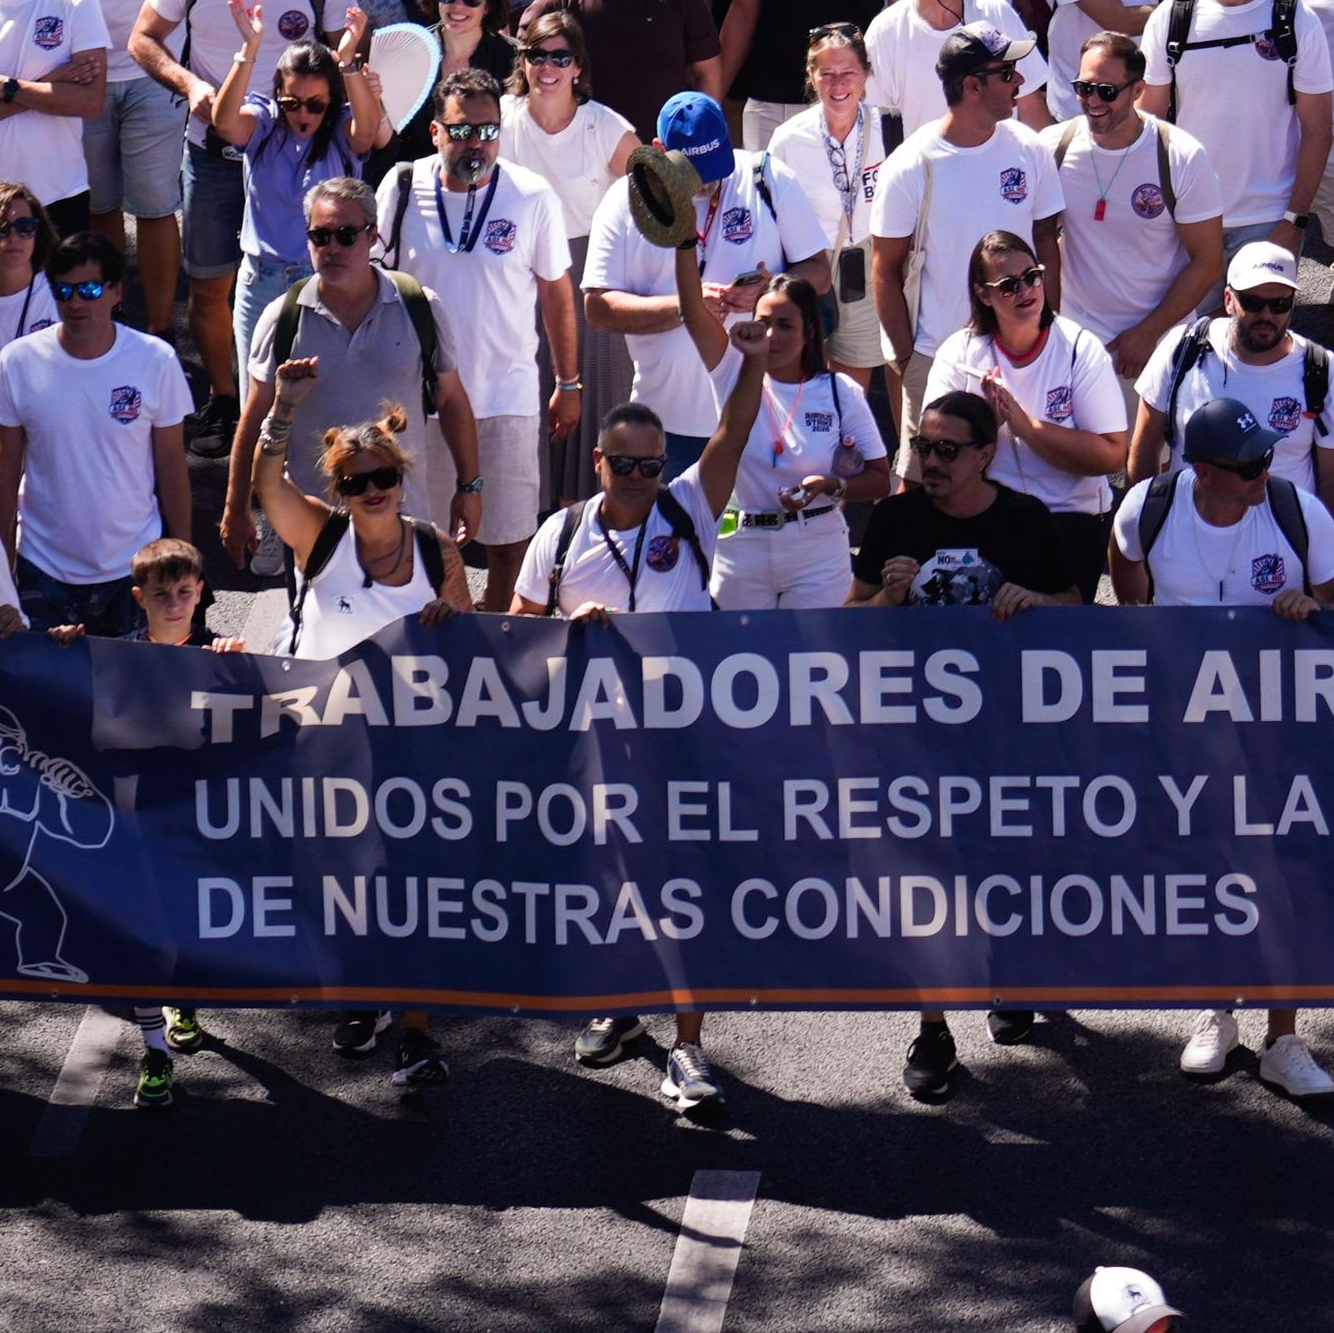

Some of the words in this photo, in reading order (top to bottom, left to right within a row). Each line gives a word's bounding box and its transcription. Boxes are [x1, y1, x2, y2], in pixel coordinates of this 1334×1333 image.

[681, 137, 720, 157] AIRBUS
[1253, 261, 1284, 272] AIRBUS
[805, 412, 833, 421] AIRBUS
[937, 557, 951, 566] NO
[190, 647, 985, 745] TRABAJADORES
[1020, 648, 1151, 724] DE
[195, 774, 473, 840] UNIDOS
[497, 777, 640, 848] POR
[668, 780, 758, 842] EL
[784, 773, 1138, 842] RESPETO
[1159, 775, 1212, 837] Y
[1232, 774, 1330, 837] LA
[198, 875, 296, 939] DE
[323, 874, 705, 947] NUESTRAS
[731, 871, 1260, 942] CONDICIONES
